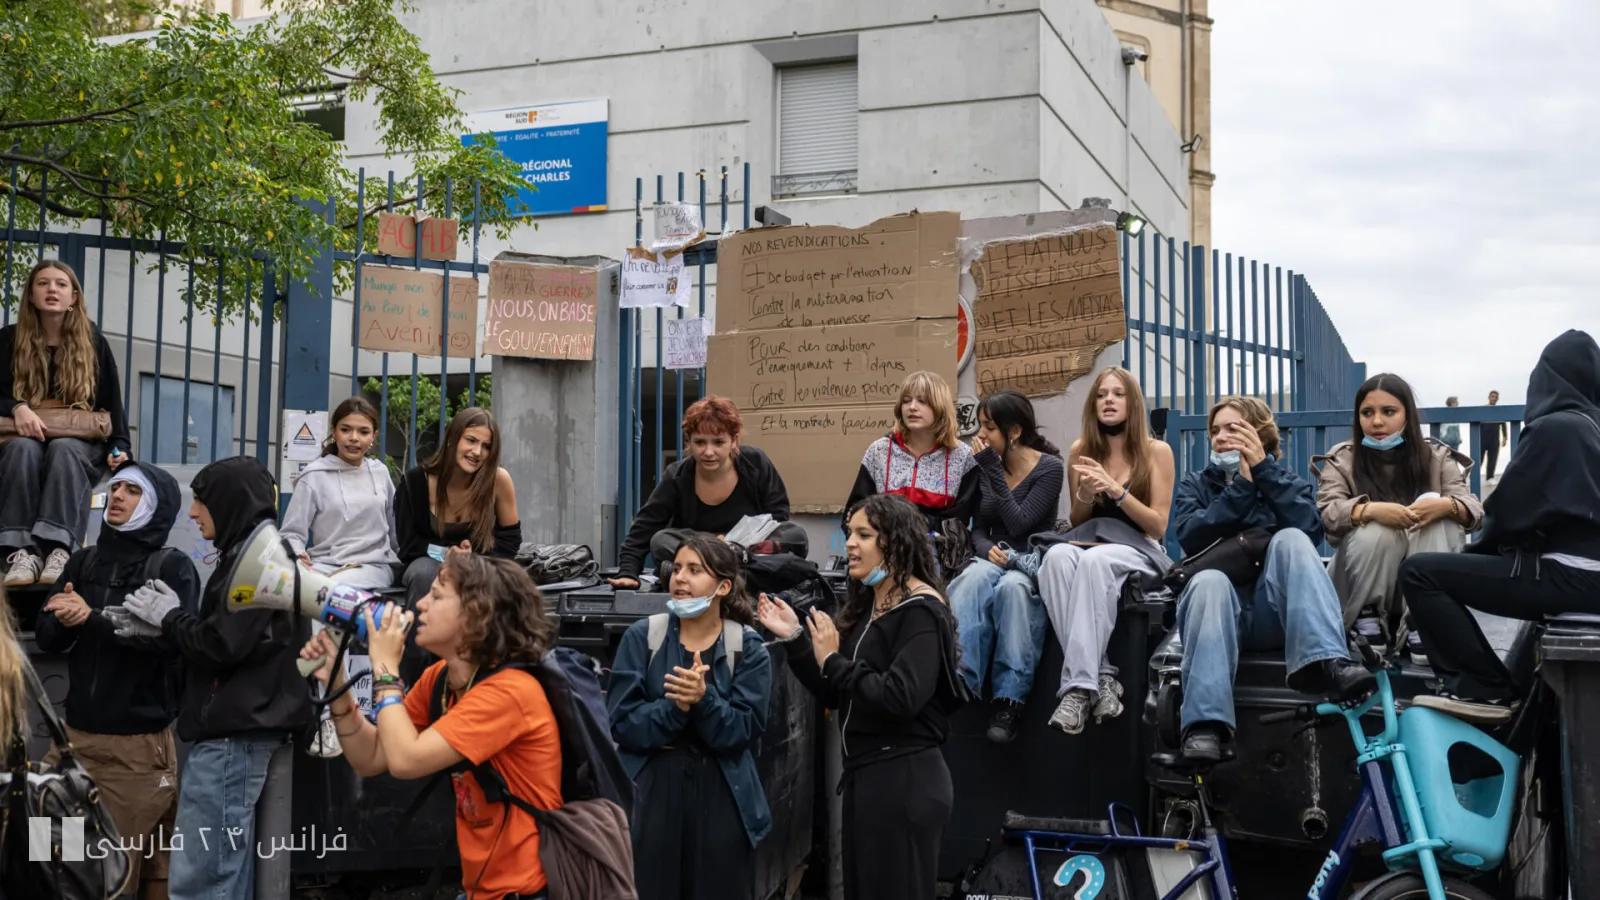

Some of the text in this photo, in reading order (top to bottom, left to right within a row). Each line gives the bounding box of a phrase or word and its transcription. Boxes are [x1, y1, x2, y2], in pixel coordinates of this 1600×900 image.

[546, 128, 580, 138] FRATERNITÉ
[521, 158, 573, 172] RÉGIONAL
[525, 171, 571, 183] CHARLES
[381, 217, 457, 253] ACAB
[742, 241, 763, 256] NOS
[766, 232, 870, 252] REVENDICATIONS
[524, 282, 536, 295] LA
[784, 267, 826, 290] budget
[417, 303, 430, 318] de
[538, 301, 558, 322] ON
[560, 301, 595, 322] BAISE
[752, 294, 785, 316] Contre
[791, 291, 801, 311] la
[778, 313, 871, 334] de la jeunesse
[991, 308, 1017, 334] ET
[1027, 301, 1064, 329] LES
[485, 320, 501, 337] LE
[668, 321, 684, 336] ON
[498, 329, 595, 355] GOUVERNEMENT
[798, 339, 820, 352] des
[752, 383, 785, 409] Contre
[760, 415, 777, 431] Et
[779, 414, 789, 430] la
[1307, 848, 1341, 900] pony
